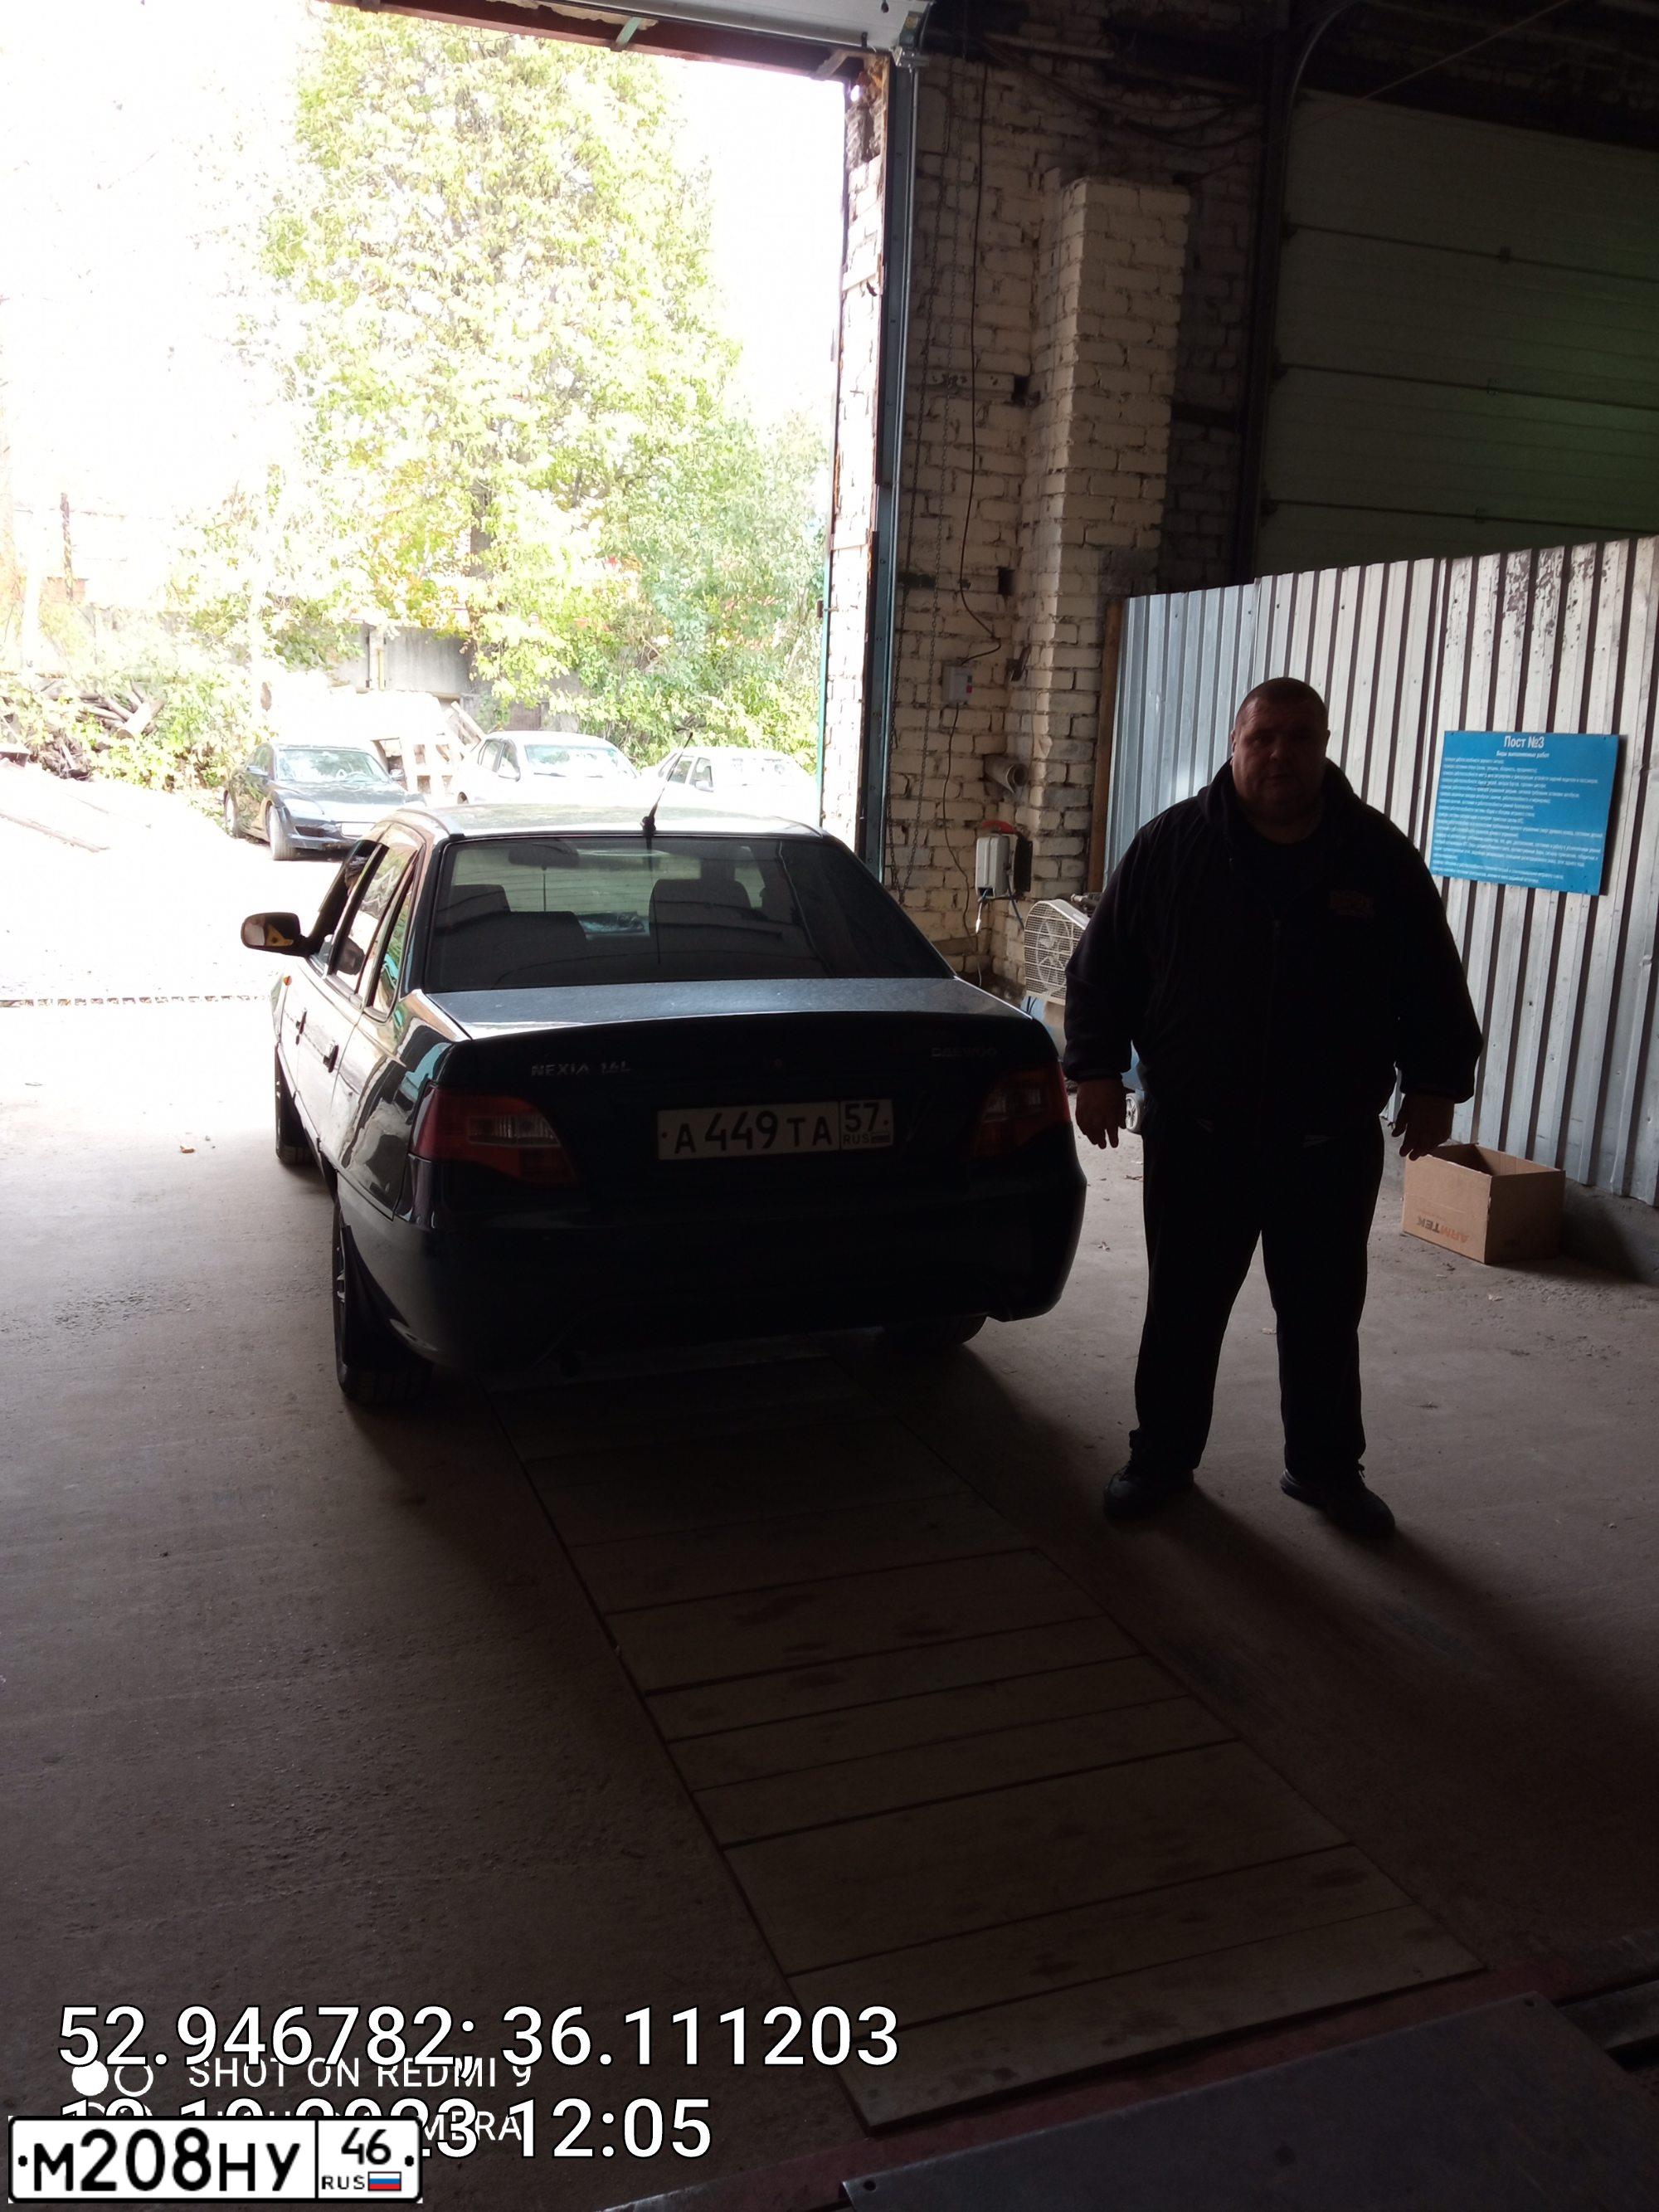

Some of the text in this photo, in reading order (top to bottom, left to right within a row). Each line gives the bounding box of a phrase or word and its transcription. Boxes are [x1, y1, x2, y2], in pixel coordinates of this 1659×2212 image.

[1504, 735, 1545, 748] Пост №3
[530, 1063, 589, 1077] NEXIA
[844, 1102, 880, 1133] 57
[842, 1133, 870, 1146] RUS
[1417, 1217, 1469, 1243] ARMTEK
